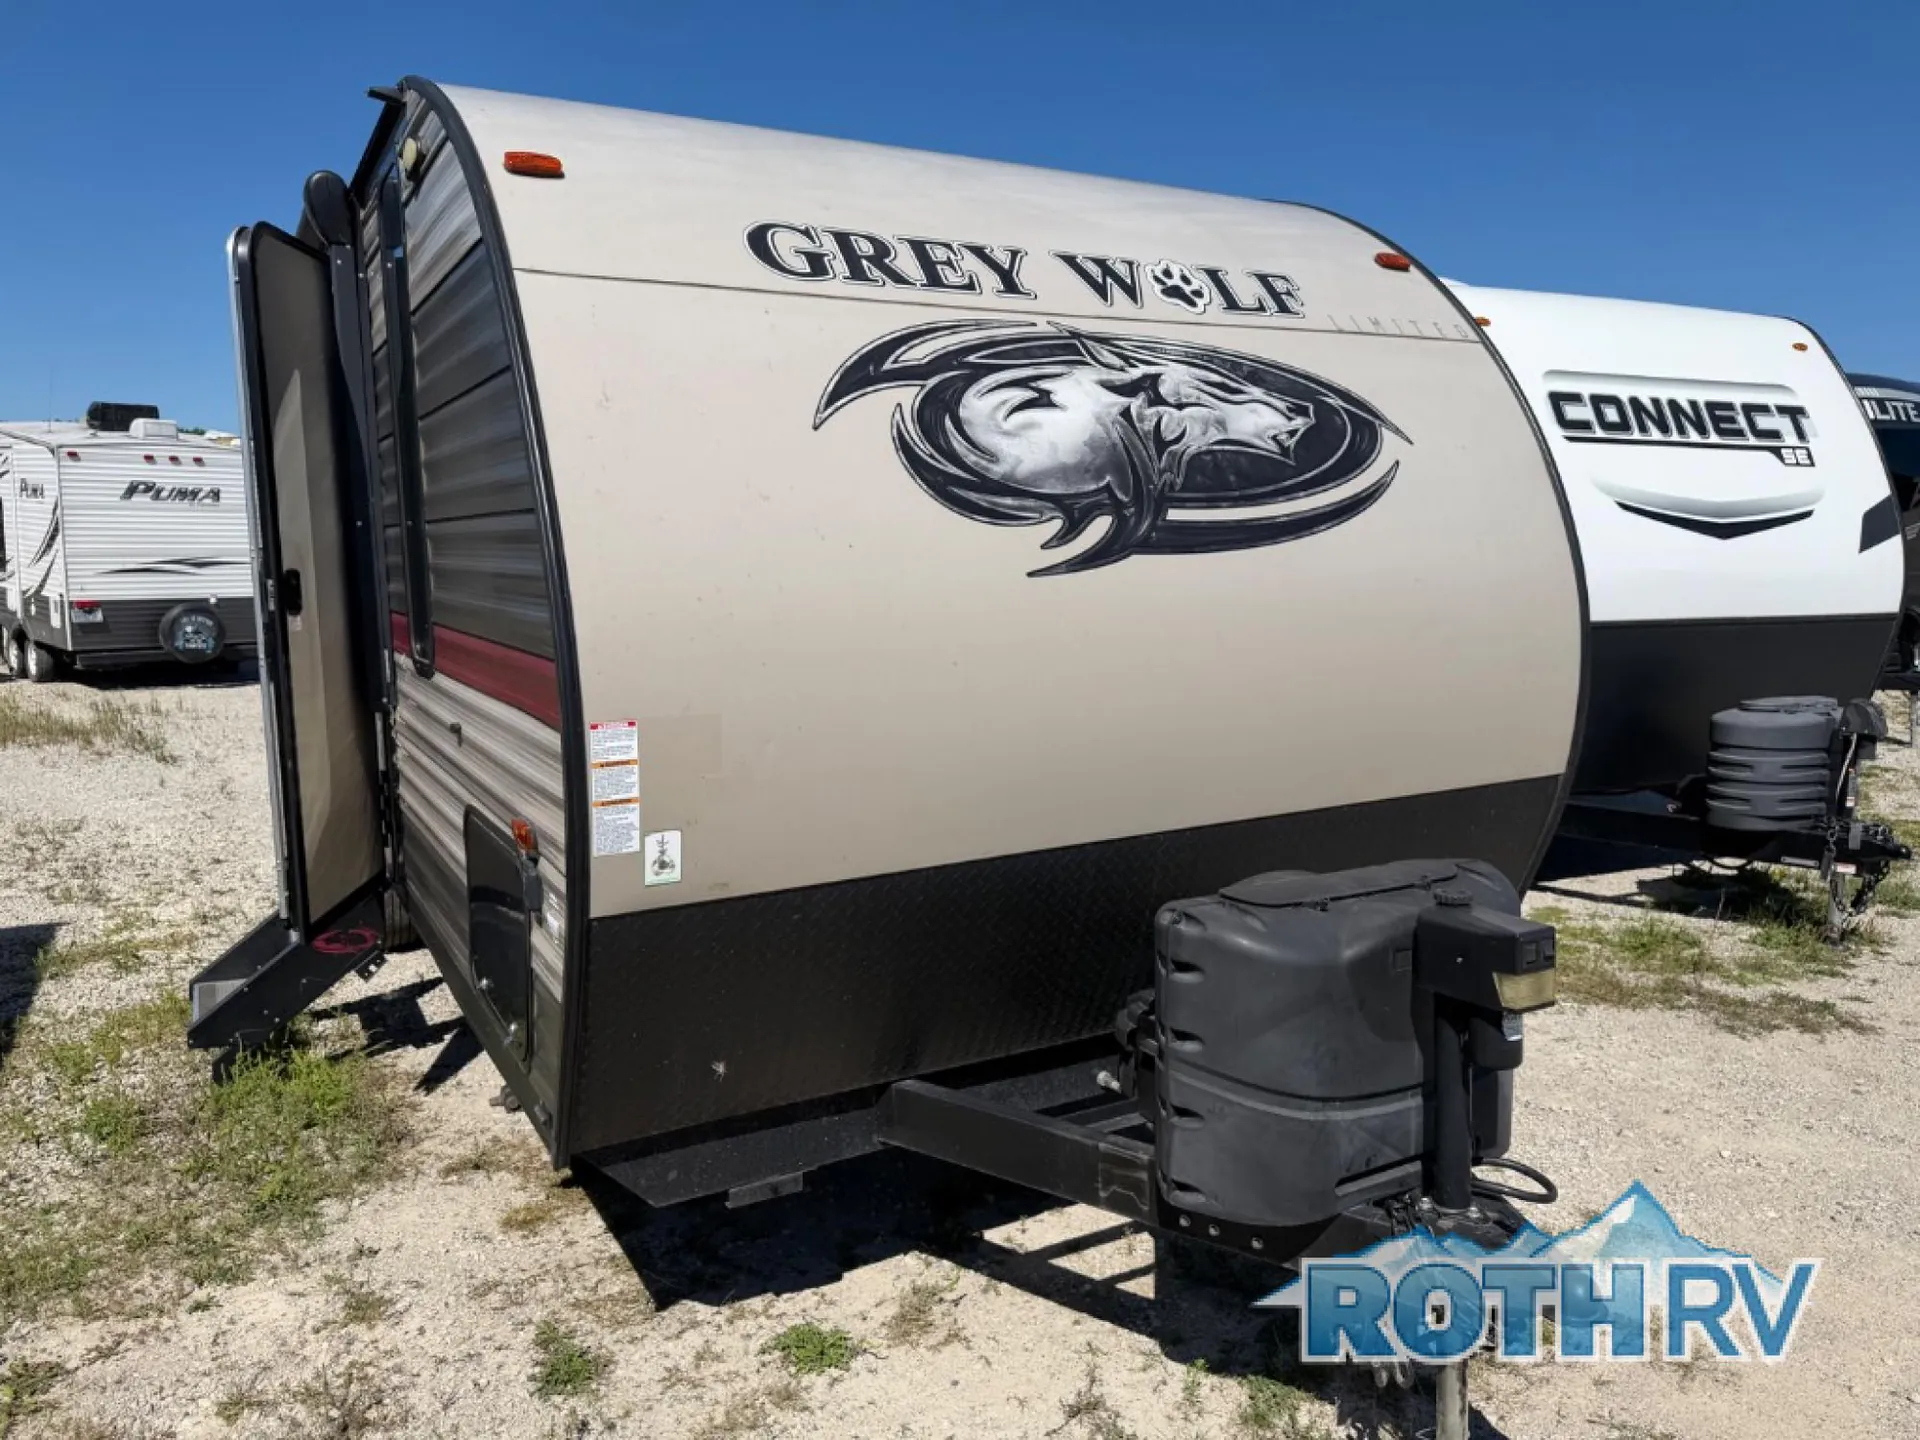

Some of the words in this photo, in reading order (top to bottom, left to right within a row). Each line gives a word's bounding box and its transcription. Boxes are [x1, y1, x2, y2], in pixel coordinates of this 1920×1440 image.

[743, 220, 1037, 301] GREY
[1547, 391, 1811, 444] CONNECT
[1780, 447, 1810, 464] SE
[119, 480, 221, 502] PUMA
